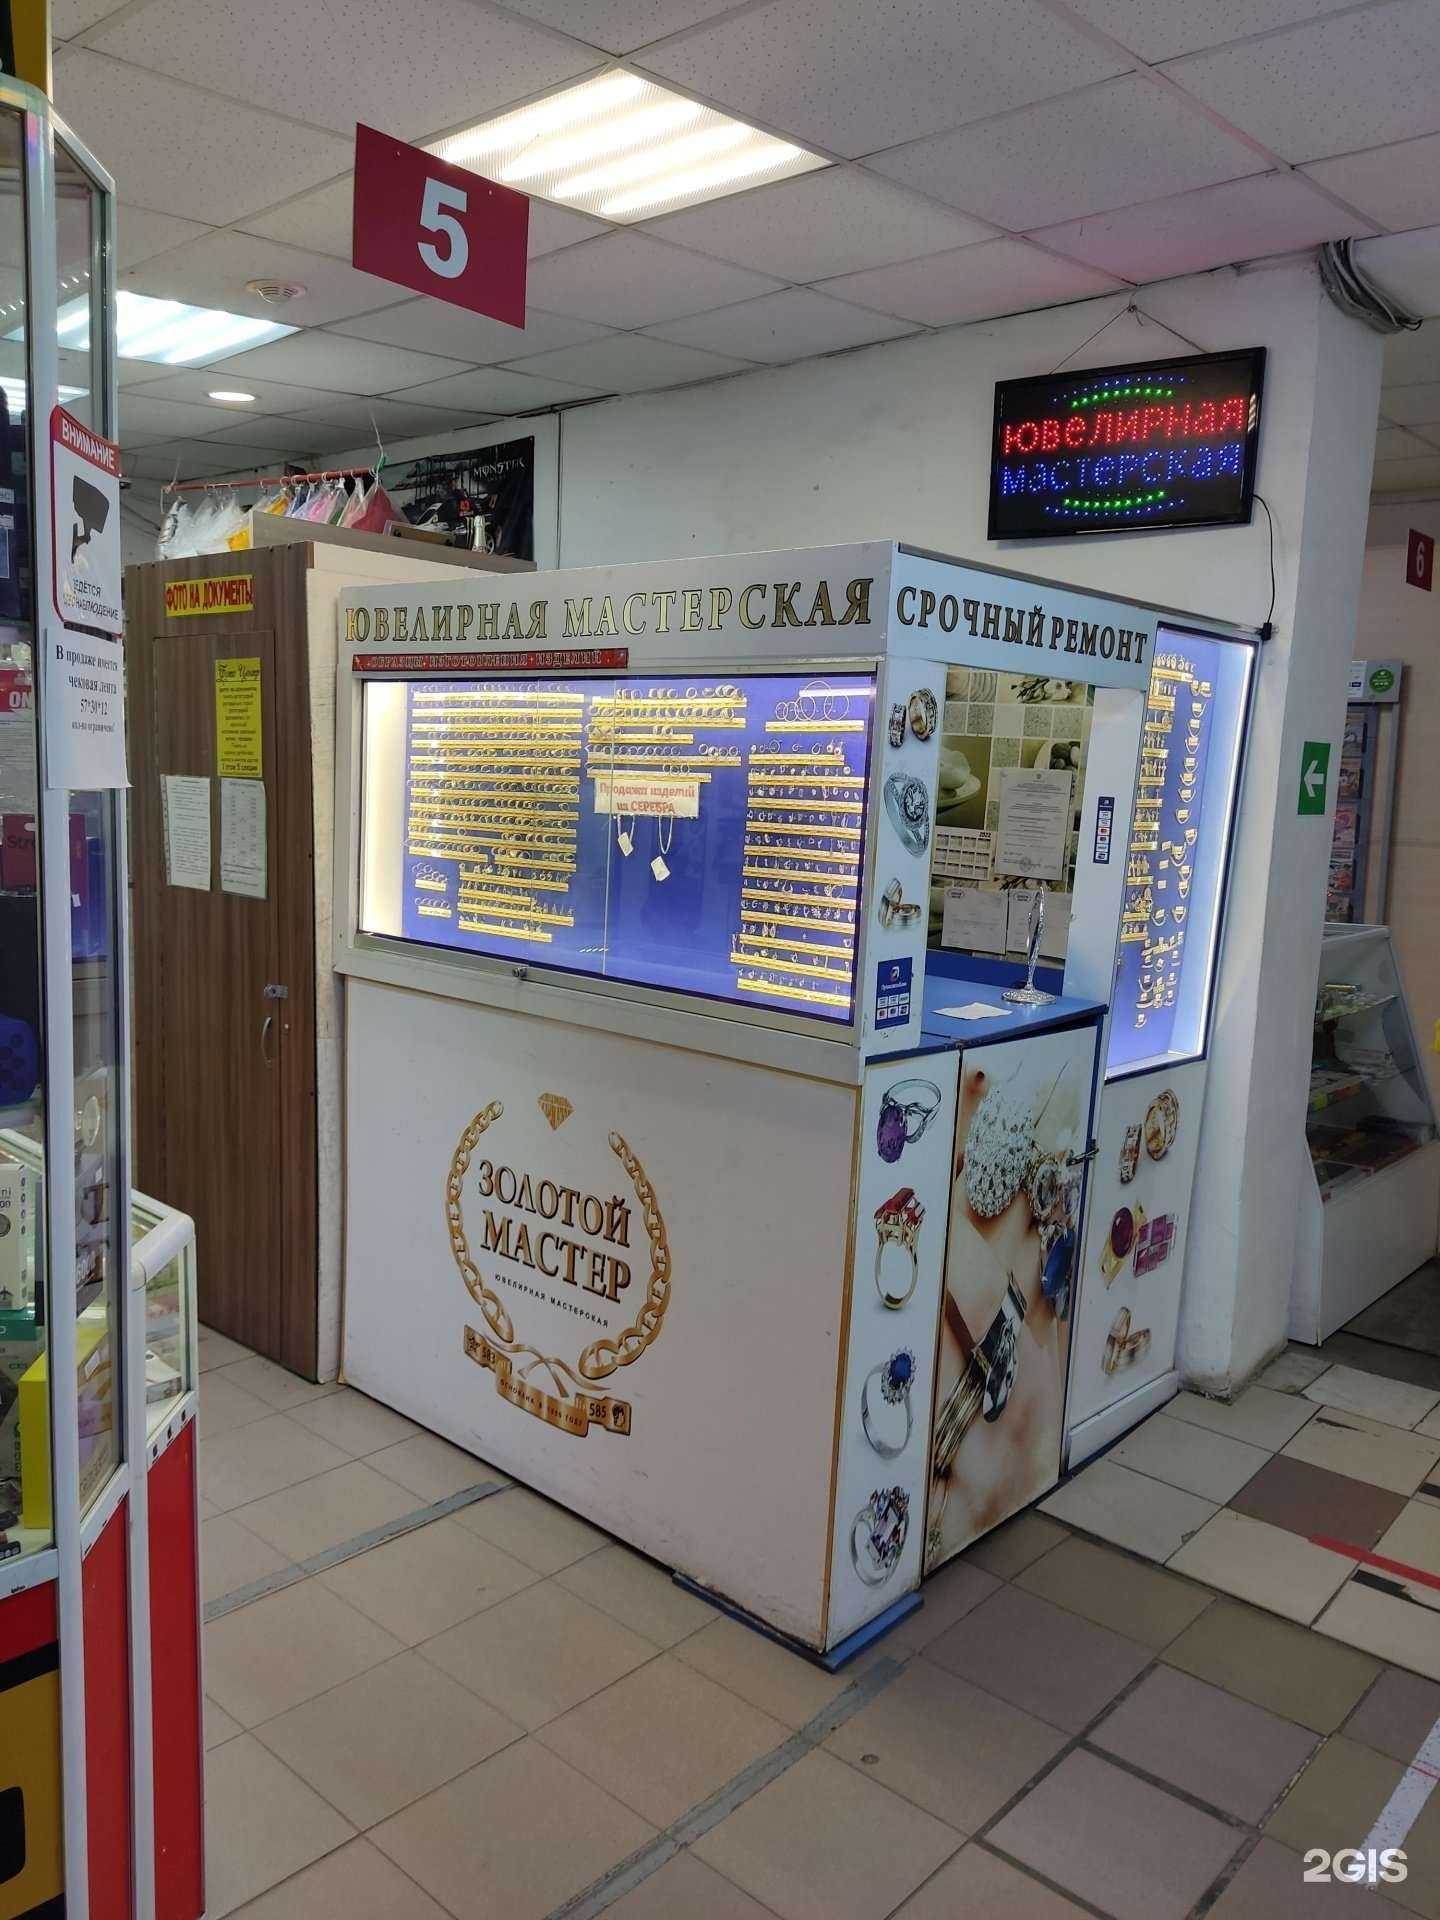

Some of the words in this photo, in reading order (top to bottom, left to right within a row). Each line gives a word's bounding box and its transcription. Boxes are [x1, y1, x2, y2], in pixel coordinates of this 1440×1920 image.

[417, 177, 469, 279] 5
[62, 418, 115, 470] ВНИМАНИЕ
[1416, 541, 1425, 578] 6
[167, 583, 187, 611] ФОТО
[190, 583, 200, 609] НА
[203, 579, 253, 610] ДОКУМЕНТЫ
[345, 600, 549, 642] ЮВЕЛИРНАЯ
[562, 578, 874, 638] МАСТЕРСКАЯ
[896, 586, 1046, 648] СРОЧНЫЙ
[1049, 616, 1148, 664] РЕМОНТ
[56, 645, 64, 659] В
[66, 651, 96, 666] продаже
[68, 675, 98, 692] чековая
[99, 681, 117, 694] лента
[600, 782, 647, 797] Продажа
[650, 784, 695, 798] изделий
[616, 802, 629, 812] из
[631, 800, 675, 813] СЕРЕБРА
[478, 1159, 632, 1248] ЗОЛОТОЙ
[480, 1210, 632, 1304] МАСТЕР
[494, 1273, 546, 1301] ЮВЕЛИРНАЯ
[550, 1296, 609, 1329] МАСТЕРСКАЯ
[589, 1402, 607, 1419] 585
